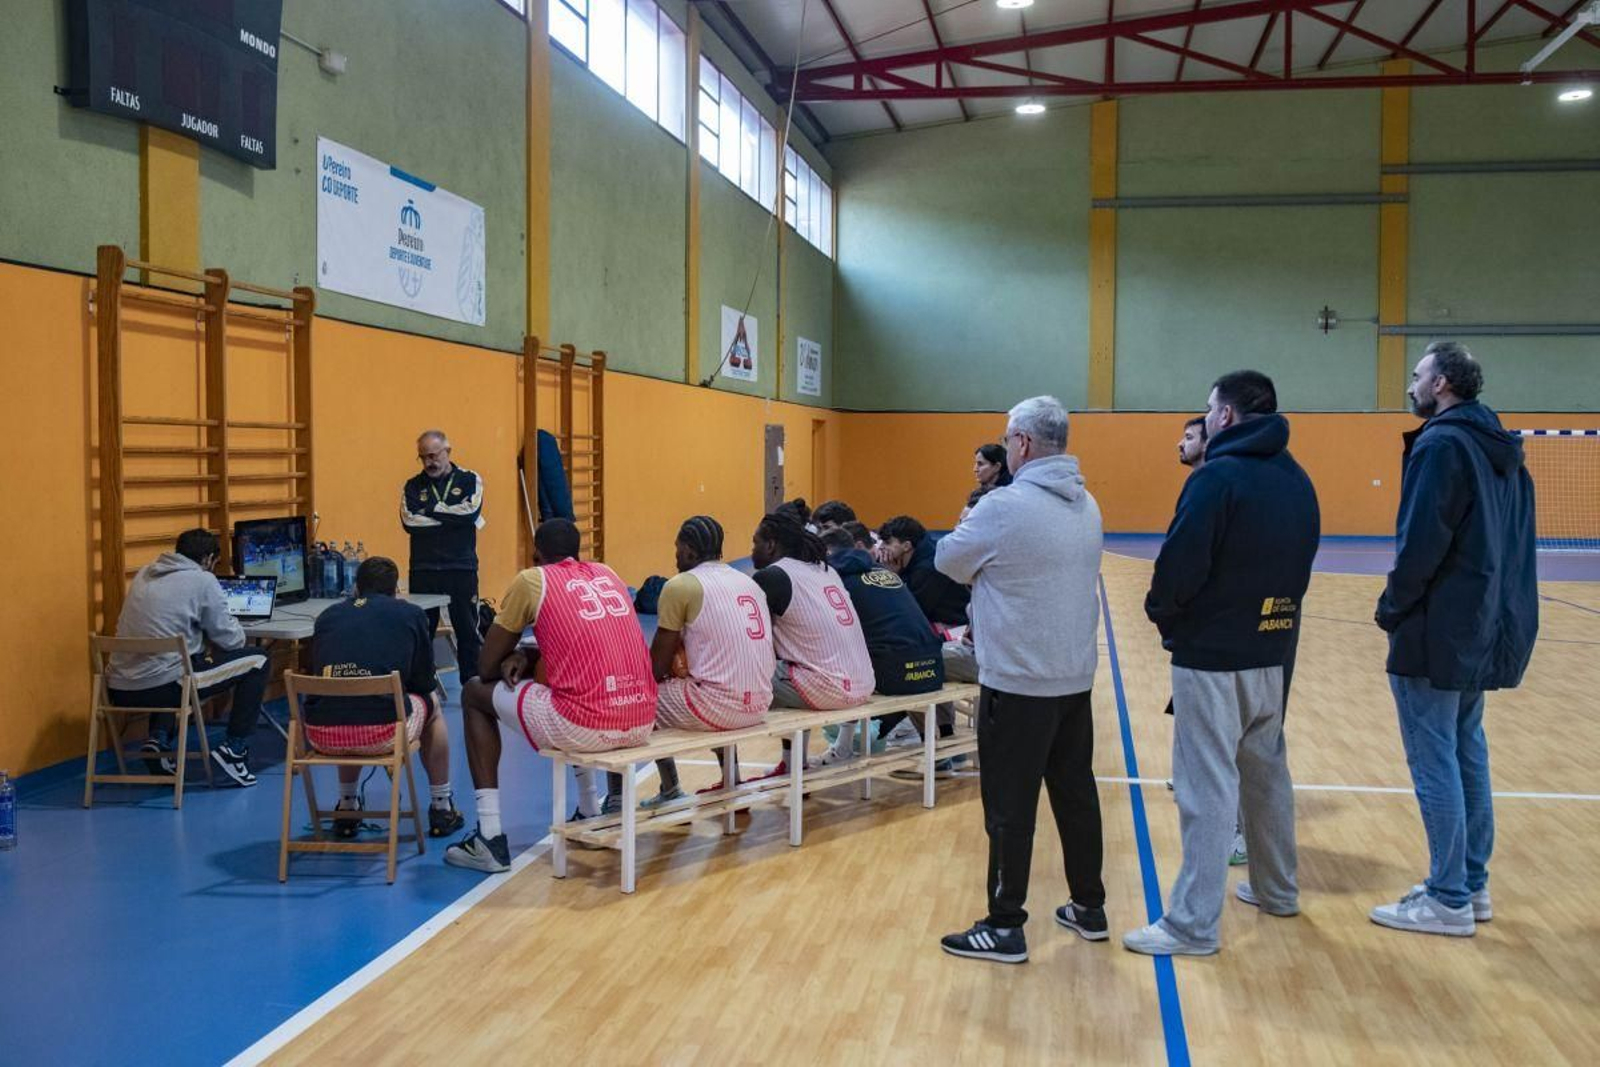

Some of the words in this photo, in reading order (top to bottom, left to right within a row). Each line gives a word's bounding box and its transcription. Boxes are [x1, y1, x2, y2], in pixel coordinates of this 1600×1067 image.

[240, 29, 276, 58] MONDO
[110, 86, 141, 111] FALTAS
[180, 112, 219, 139] JUGADOR
[240, 134, 264, 154] FALTAS
[566, 576, 630, 621] 35
[824, 585, 854, 626] 9
[737, 595, 765, 640] 3
